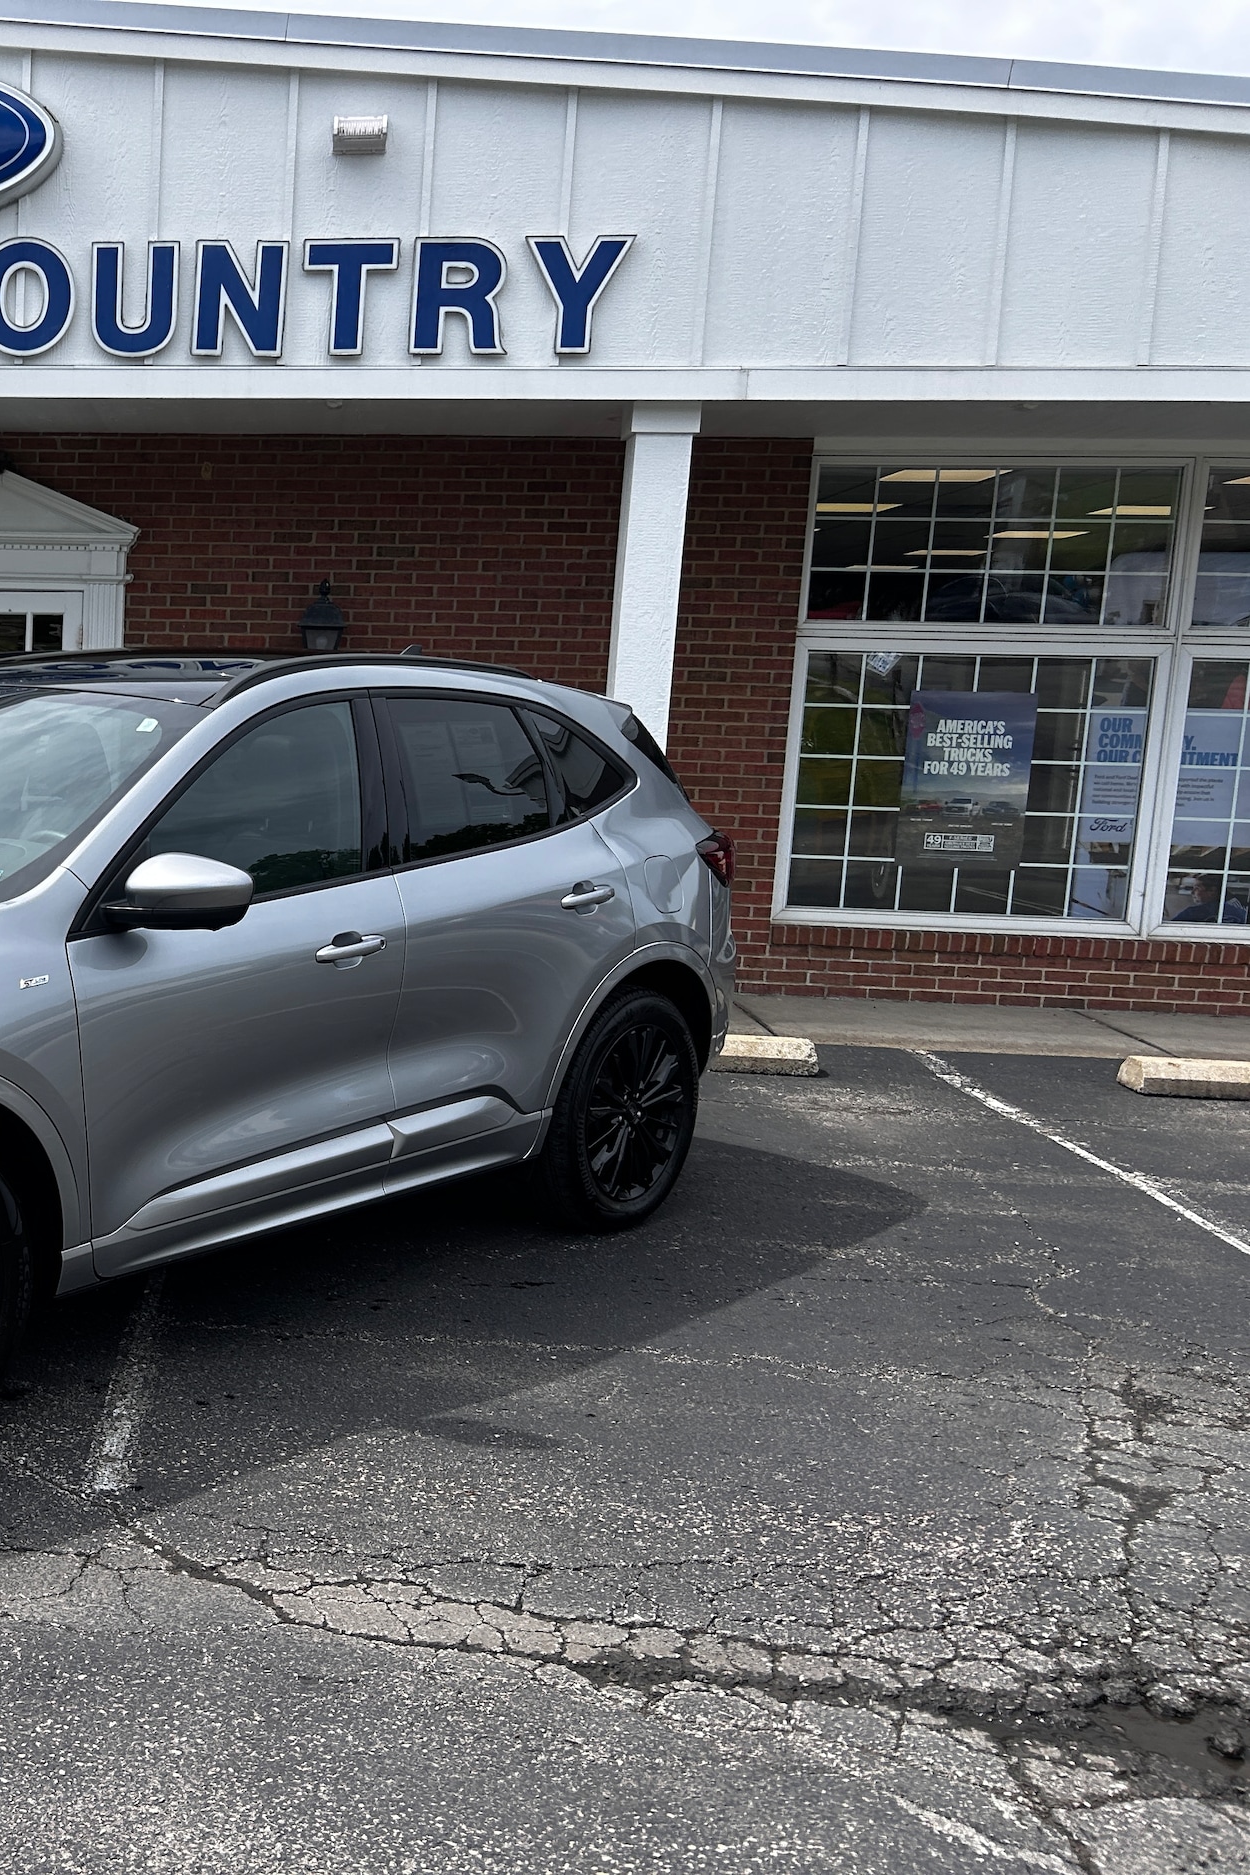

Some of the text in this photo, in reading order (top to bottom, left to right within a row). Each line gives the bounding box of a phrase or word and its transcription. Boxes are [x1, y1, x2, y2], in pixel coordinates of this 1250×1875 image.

[936, 719, 1006, 735] AMERICA'S
[1100, 717, 1133, 733] OUR
[926, 733, 1013, 749] BEST-SELLING
[943, 747, 993, 763] TRUCKS
[1096, 749, 1130, 763] OUR
[923, 760, 1011, 777] FOR 49 YEARS
[1089, 817, 1128, 832] Ford
[926, 835, 942, 844] 49
